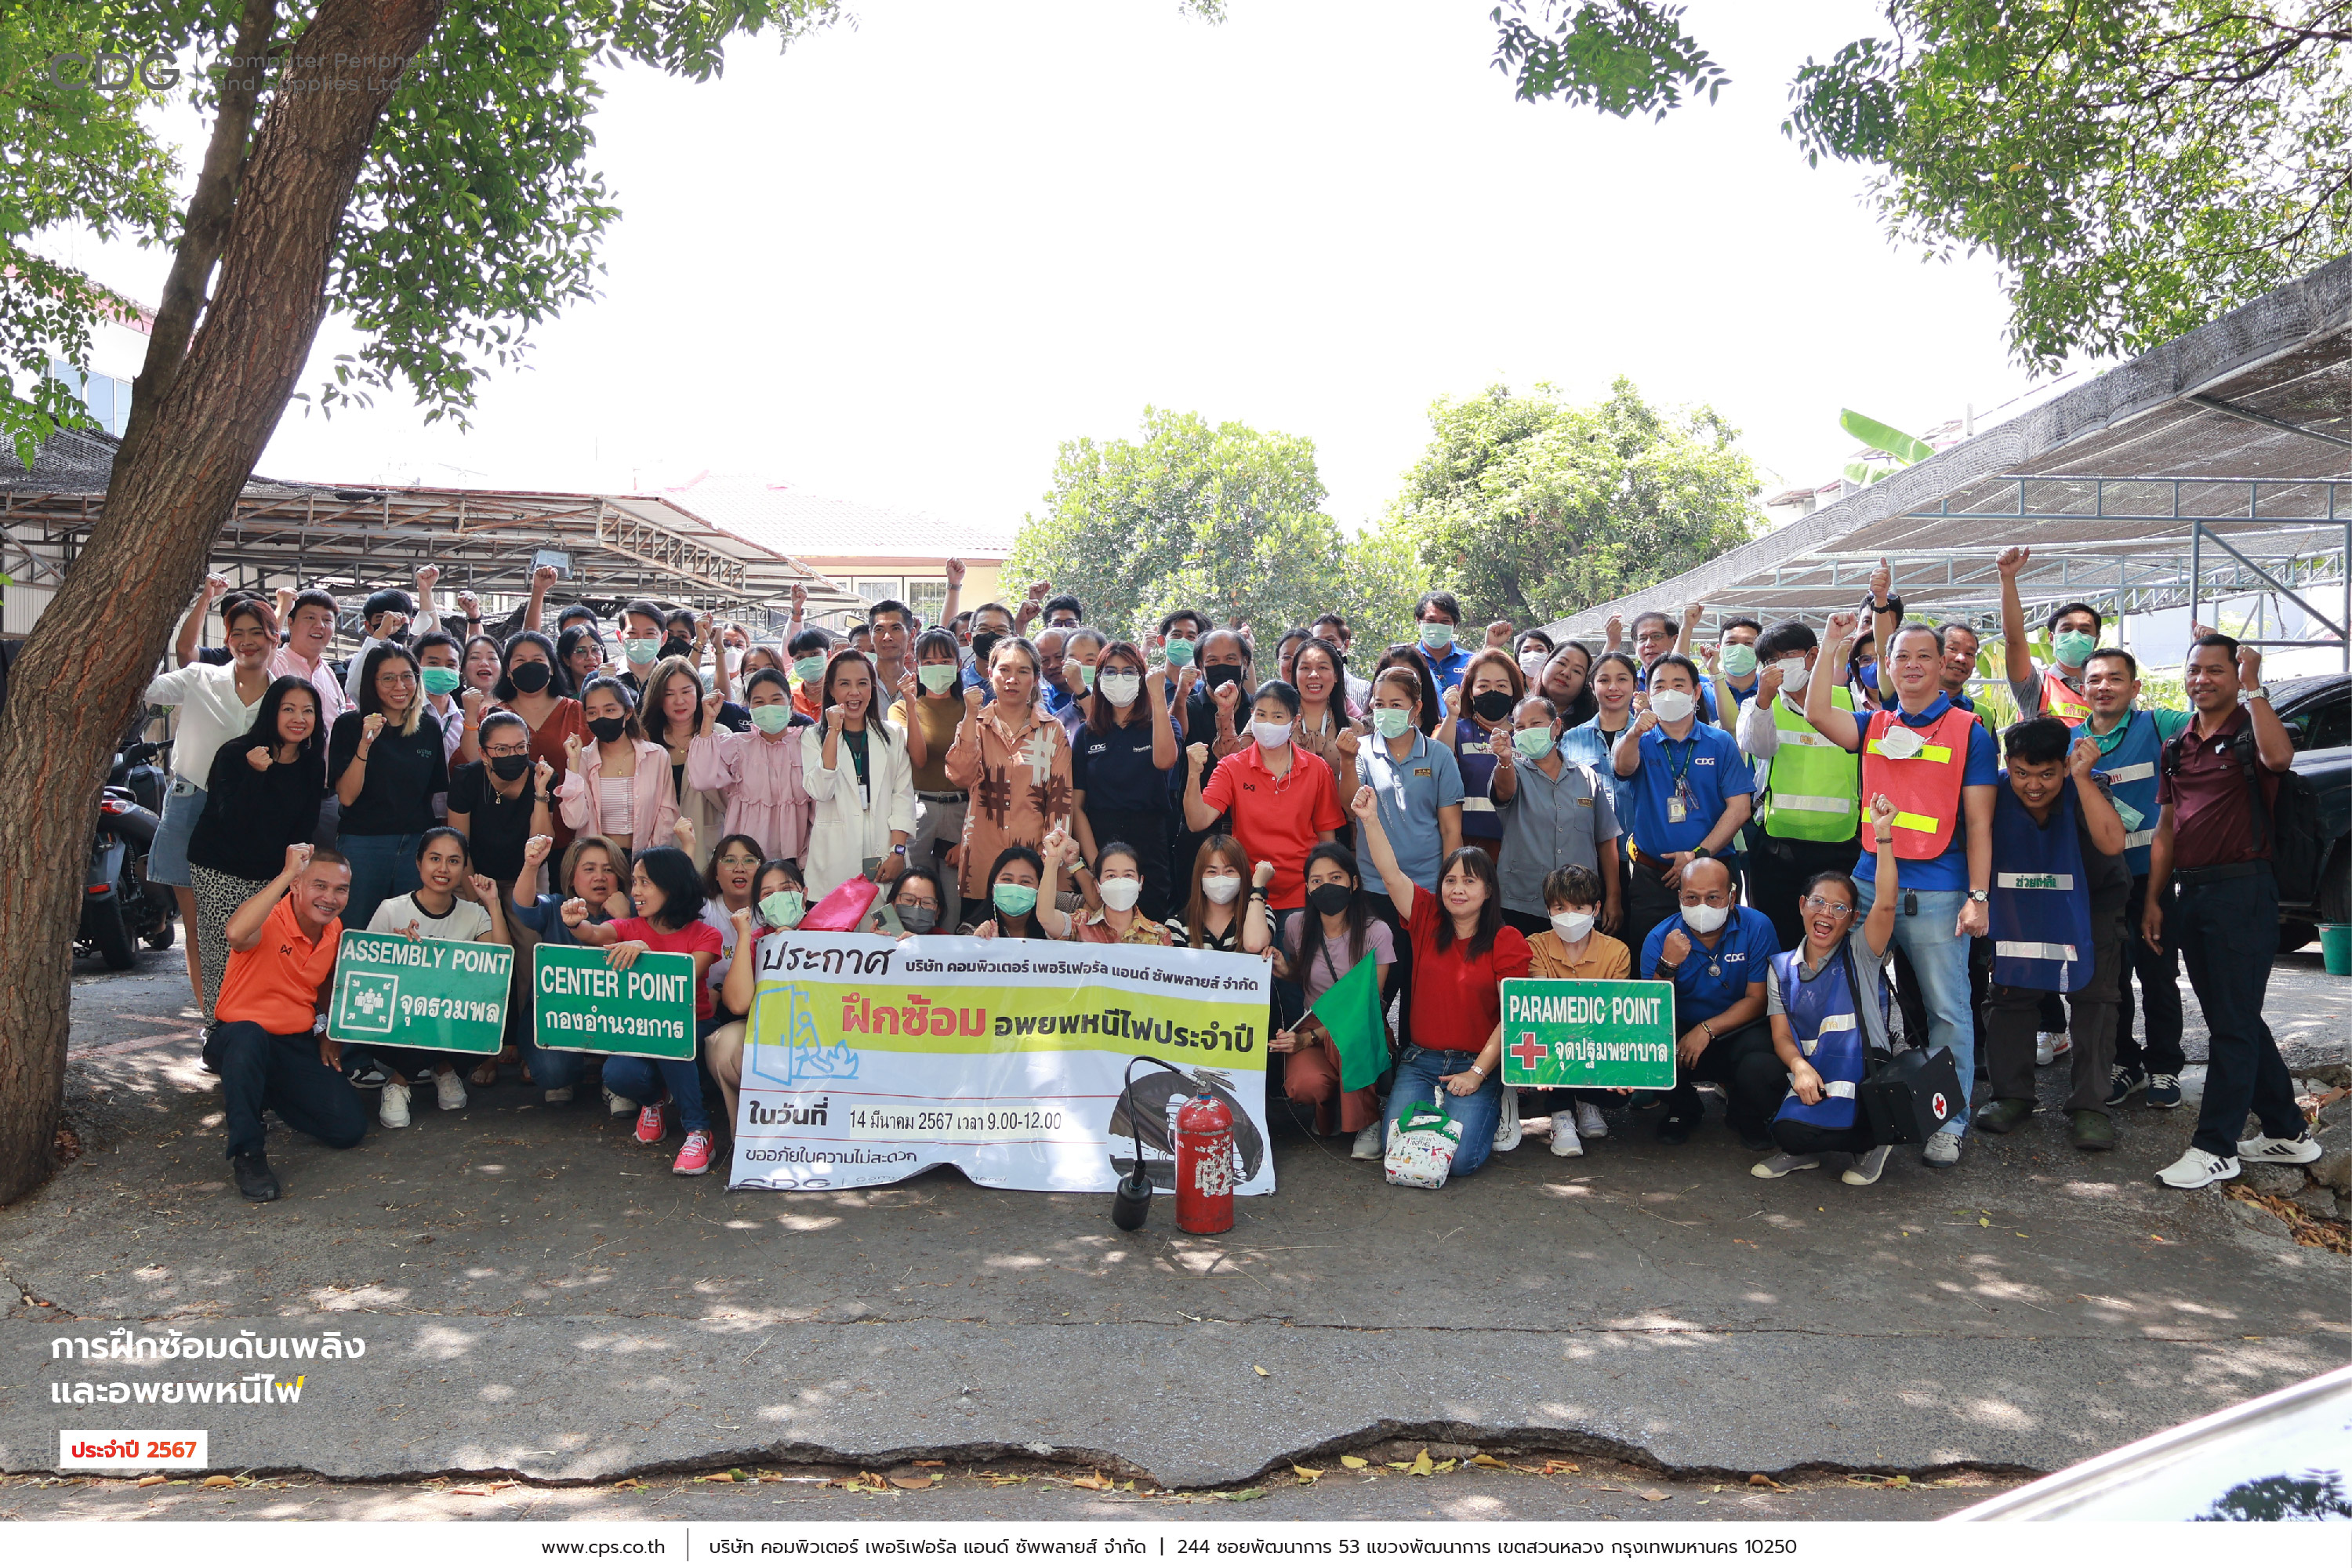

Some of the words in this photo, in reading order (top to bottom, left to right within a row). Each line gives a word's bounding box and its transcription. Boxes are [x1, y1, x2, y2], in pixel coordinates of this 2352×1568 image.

[342, 939, 445, 968] ASSEMBLY
[452, 949, 510, 975] POINT
[762, 941, 898, 975] ประกาศ
[906, 959, 943, 972] บริษัท
[947, 959, 1029, 974] คอมพิวเตอร์
[1033, 960, 1109, 975] เพอริเฟอรัล
[1112, 967, 1150, 981] แอนด์
[1152, 969, 1220, 989] ซัพพลายส์
[1223, 978, 1258, 991] จำกัด
[1724, 953, 1746, 963] CDG
[540, 965, 619, 998] CENTER
[628, 971, 688, 1003] POINT
[400, 994, 500, 1027] จุดรวมพล
[545, 1004, 684, 1039] กองอำนวยการ
[841, 992, 986, 1037] ฝึกซ้อม
[995, 1007, 1254, 1053] อพยพหนีไฟประจำปี
[1509, 995, 1605, 1025] PARAMEDIC
[1612, 996, 1661, 1025] POINT
[750, 1097, 829, 1126] ในวันที่
[850, 1109, 866, 1129] 14
[870, 1109, 914, 1130] มีนาคม
[918, 1112, 953, 1130] 2567
[957, 1114, 984, 1131] เวลา
[987, 1111, 1062, 1130] 9.00-12.00
[746, 1146, 917, 1164] ขออภัยในความไม่สะดวก
